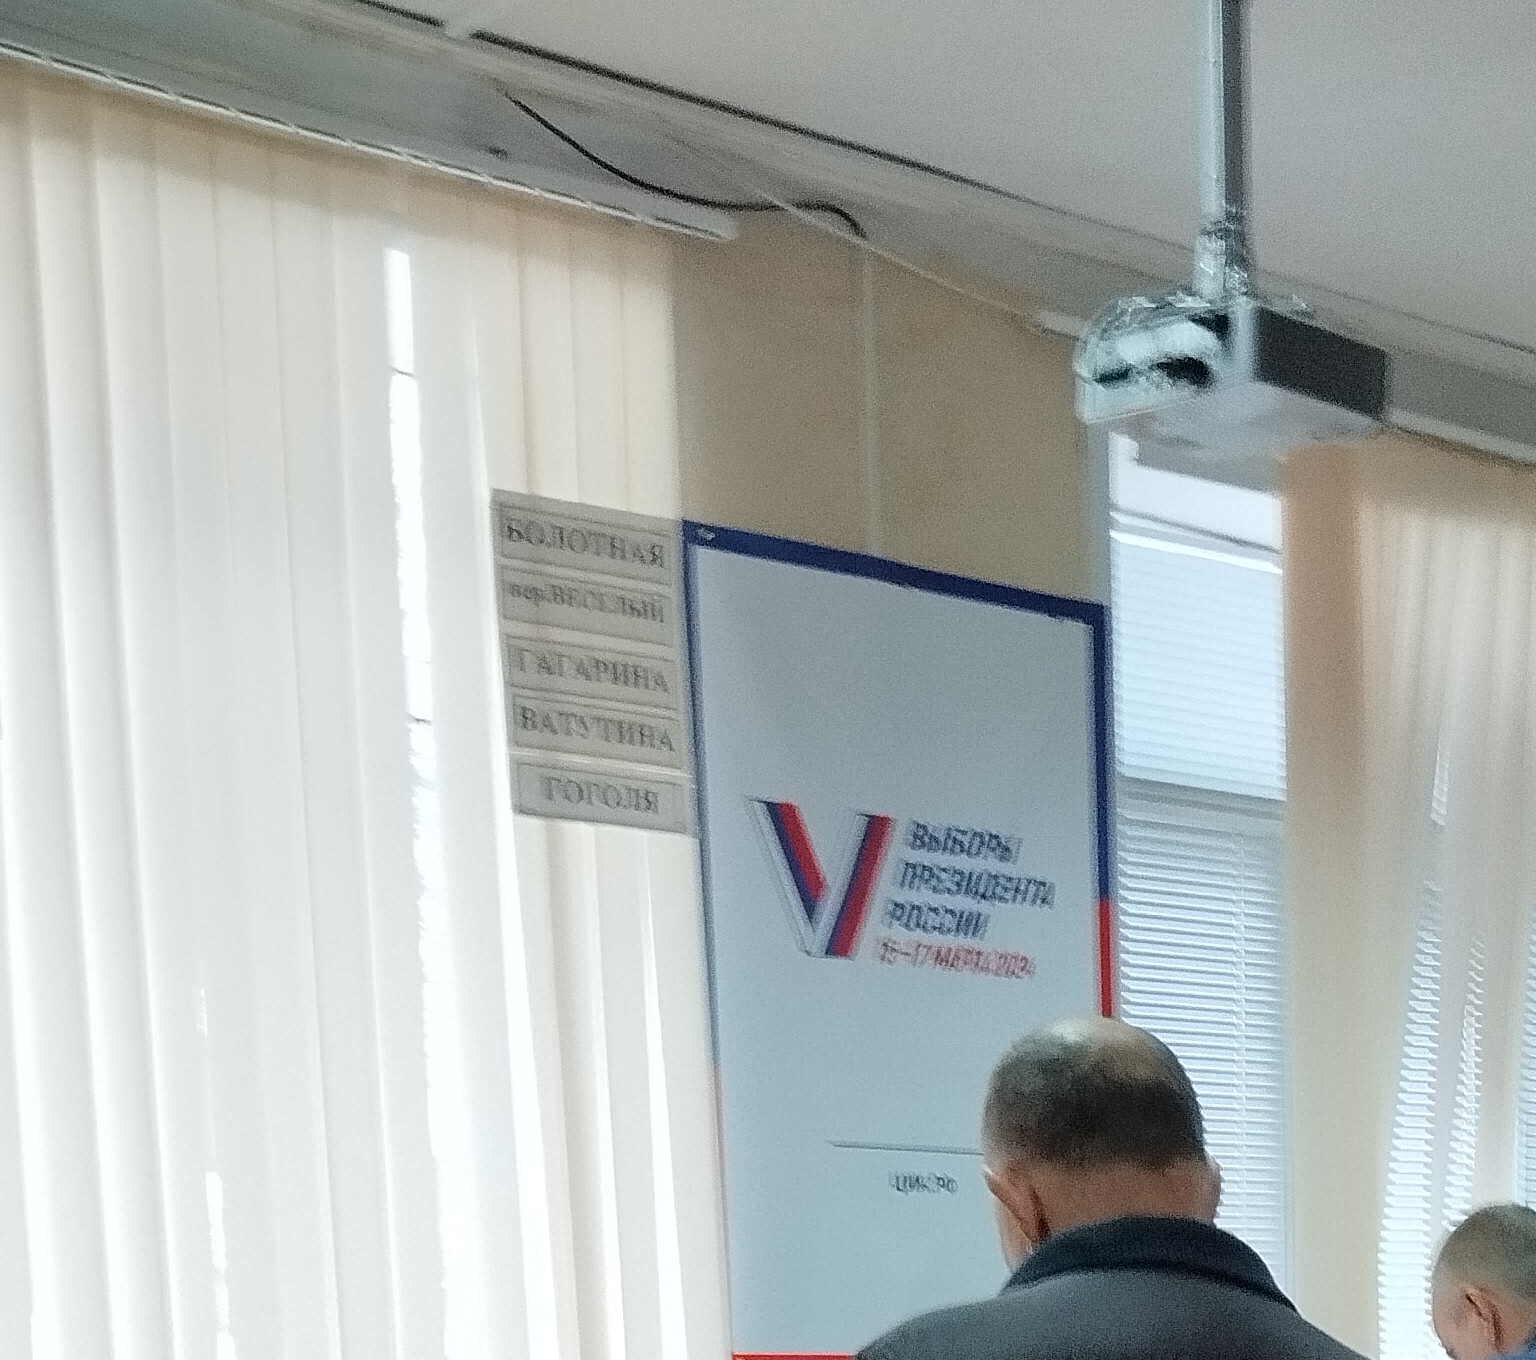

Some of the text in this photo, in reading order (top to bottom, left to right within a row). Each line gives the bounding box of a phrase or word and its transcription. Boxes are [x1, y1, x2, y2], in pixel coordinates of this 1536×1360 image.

[505, 520, 666, 568] БОЛОТНАЯ
[516, 646, 671, 694] ГАГАРИНА
[519, 705, 676, 753] ВАТУТИНА
[540, 775, 661, 816] ГОГОЛЯ
[908, 818, 1024, 866] ВЫБОРЫ
[896, 860, 1057, 911] ПРЕЗИДЕНТА
[883, 899, 991, 941] РОССИИ
